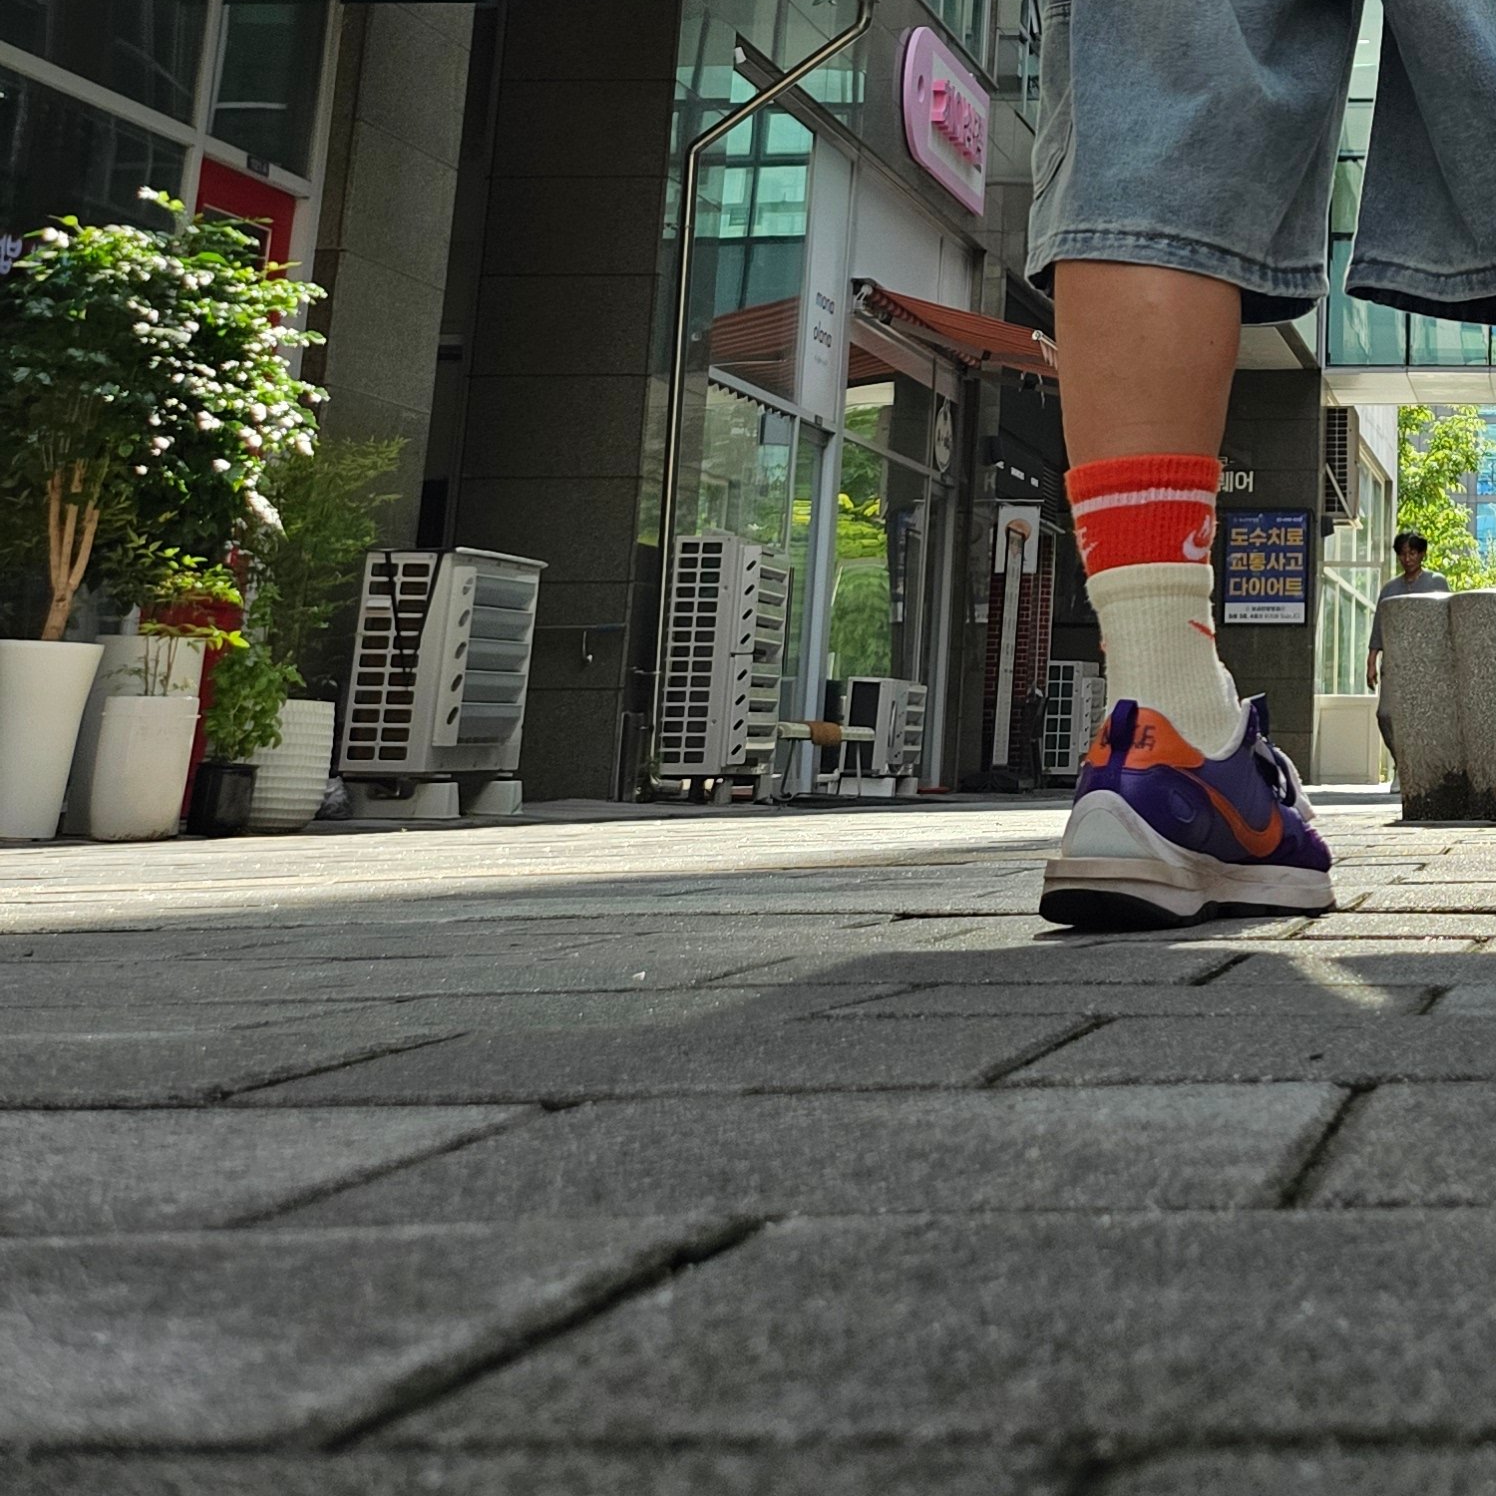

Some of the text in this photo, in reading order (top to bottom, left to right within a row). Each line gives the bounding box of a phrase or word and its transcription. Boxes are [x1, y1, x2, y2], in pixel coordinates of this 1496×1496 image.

[1230, 527, 1304, 547] 도수치료
[1229, 552, 1304, 572] 교통사고
[1229, 577, 1303, 597] 다이어트
